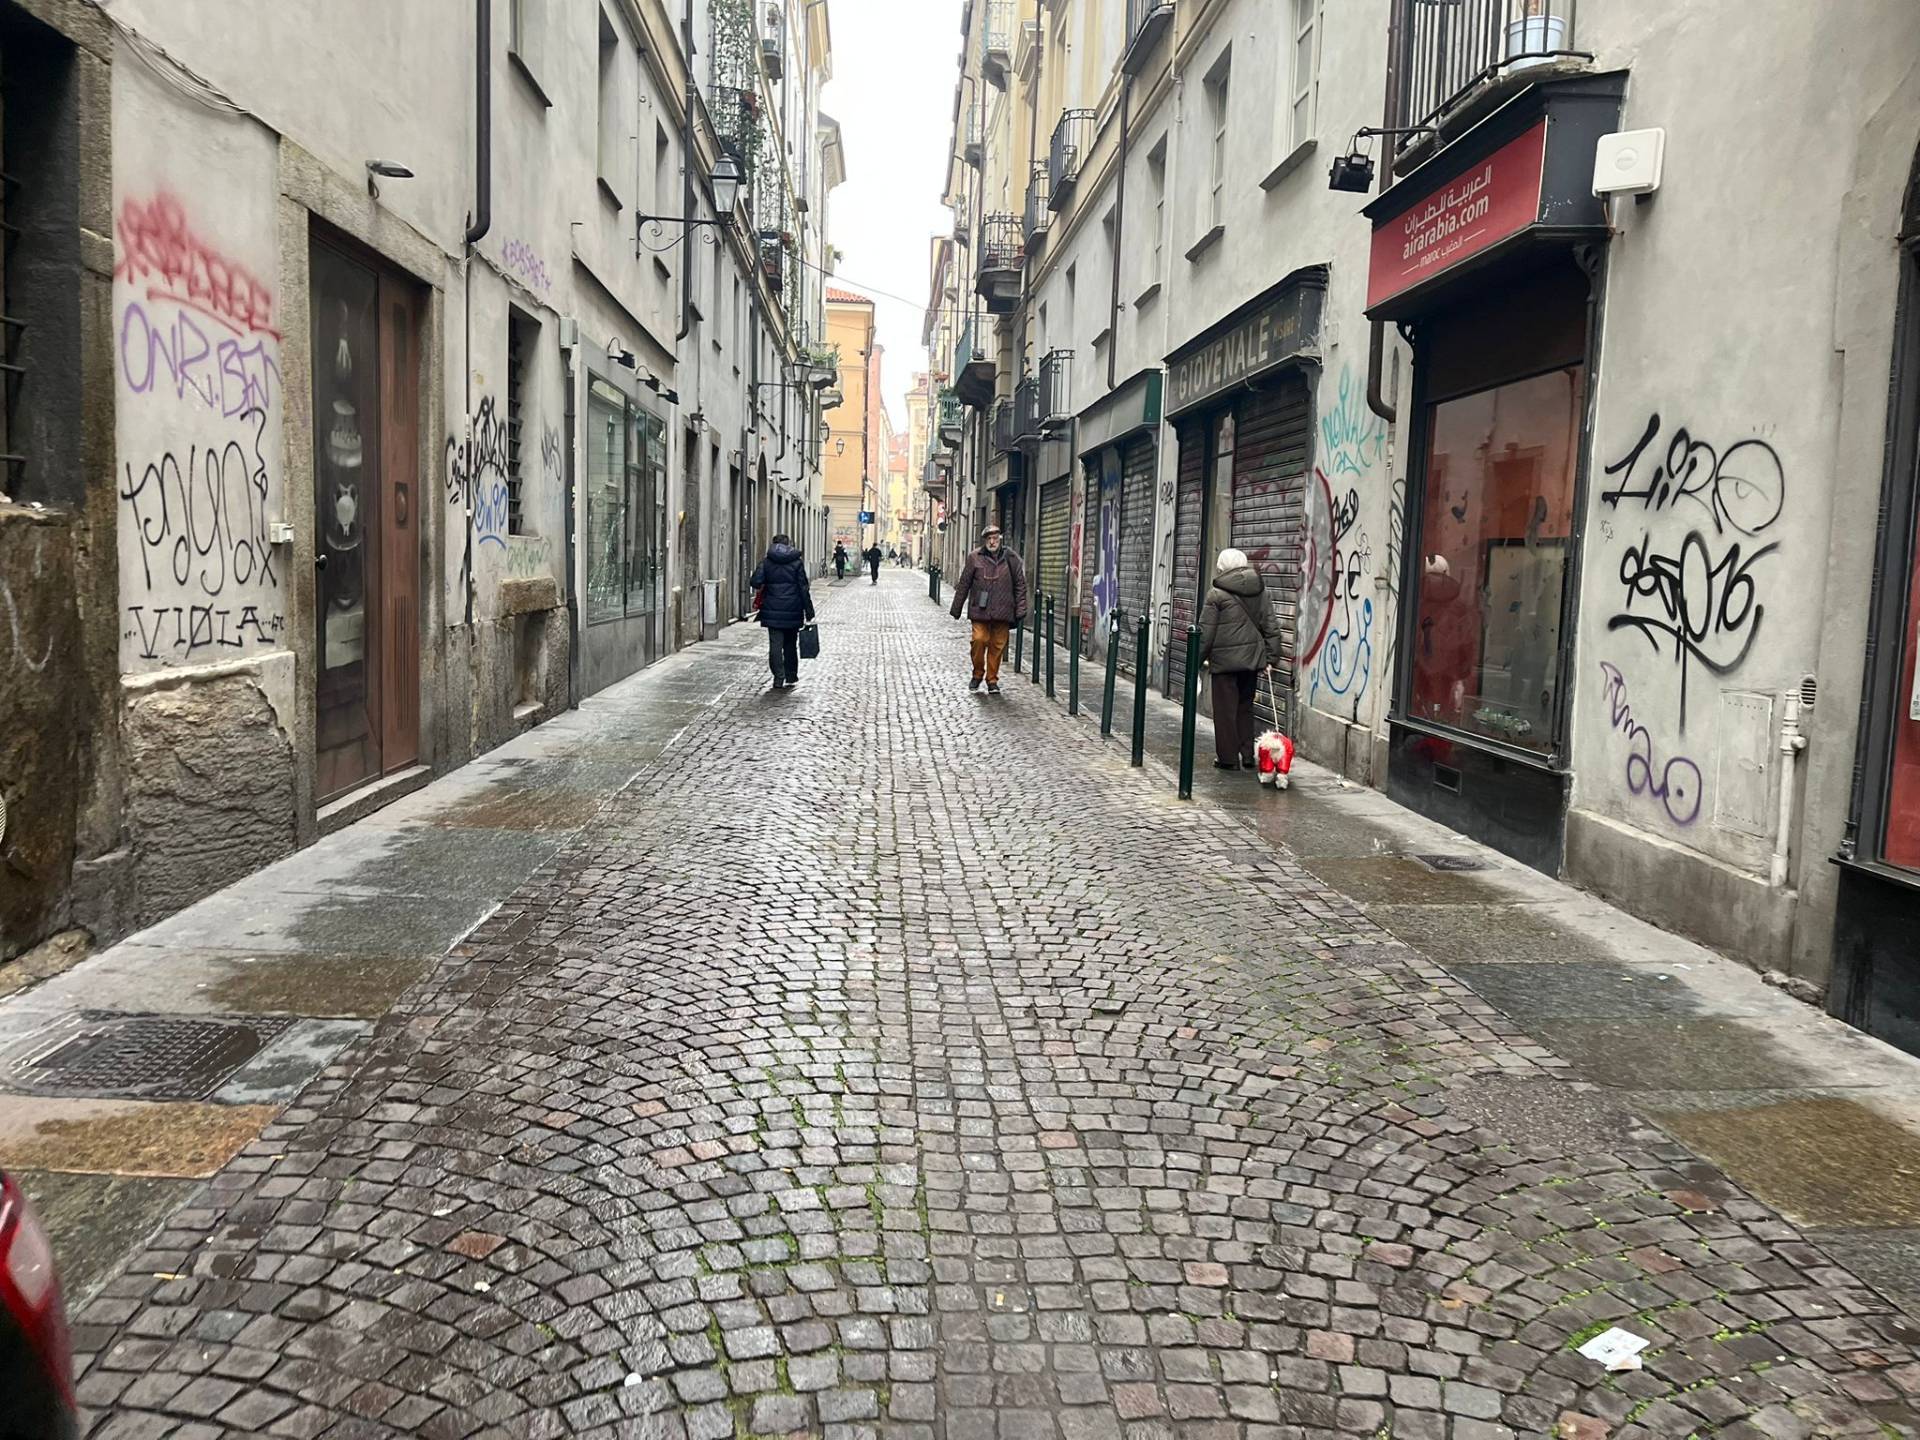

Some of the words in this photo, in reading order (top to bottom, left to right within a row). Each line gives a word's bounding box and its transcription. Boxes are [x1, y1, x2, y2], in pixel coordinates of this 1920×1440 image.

[1448, 166, 1492, 208] العربية
[1403, 195, 1489, 259] airarabia.com
[1405, 194, 1447, 234] للطيران
[1420, 247, 1441, 267] maroc
[1179, 315, 1271, 400] GIOVENALE
